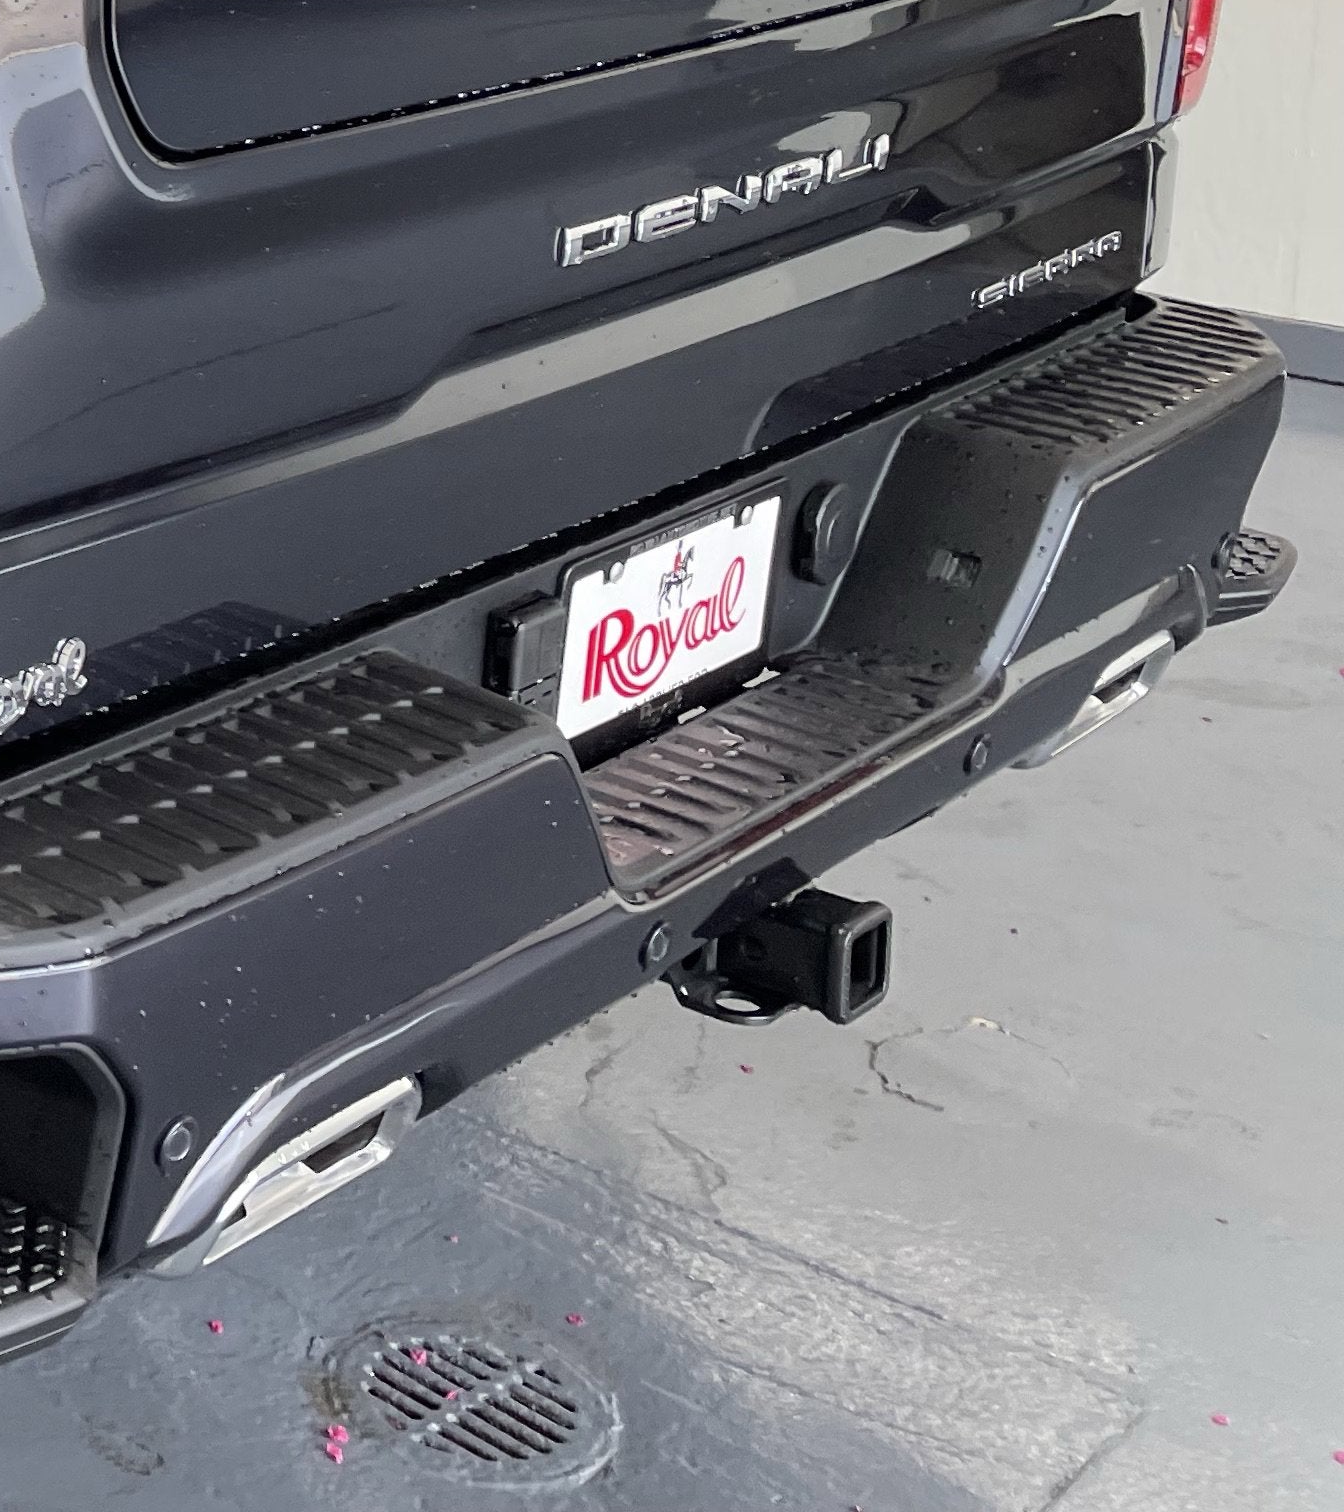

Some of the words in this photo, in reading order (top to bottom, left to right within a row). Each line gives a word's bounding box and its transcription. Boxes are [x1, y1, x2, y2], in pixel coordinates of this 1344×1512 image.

[557, 133, 890, 268] DENALI
[971, 230, 1122, 309] SIERRA
[581, 555, 747, 704] Royal
